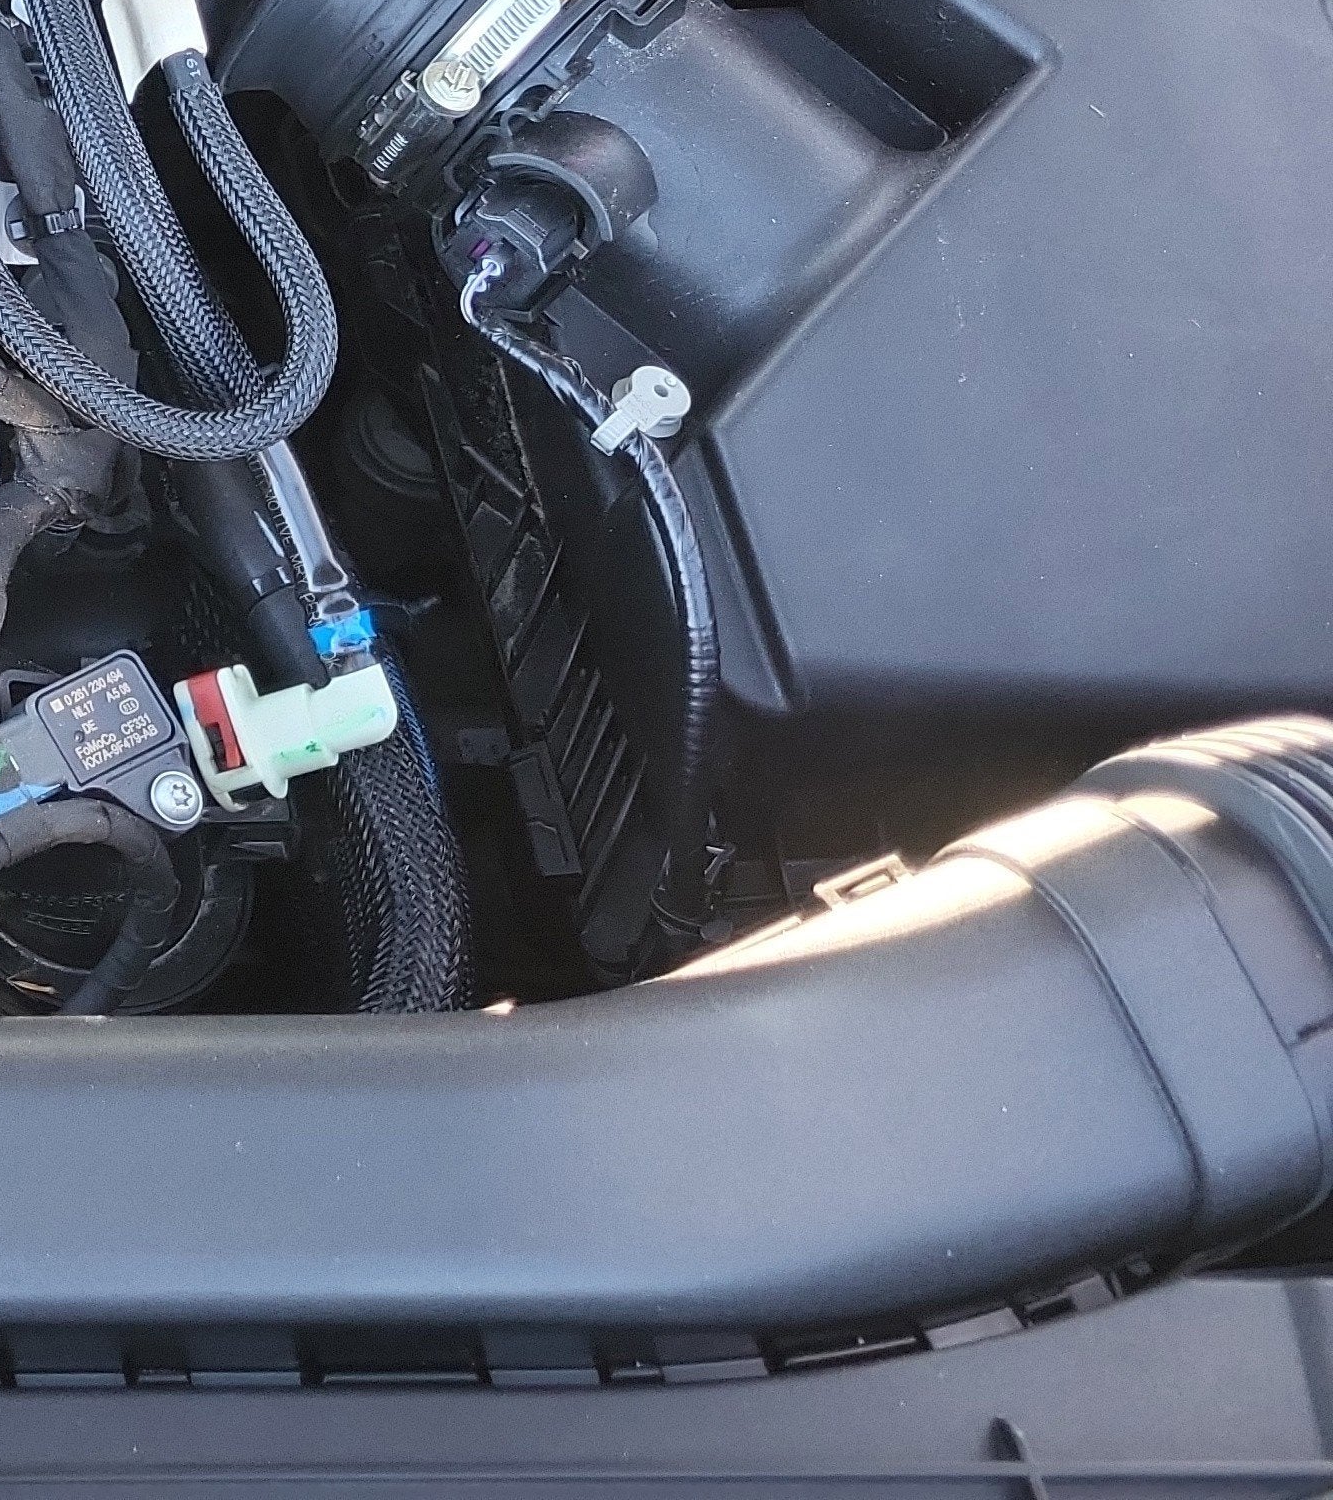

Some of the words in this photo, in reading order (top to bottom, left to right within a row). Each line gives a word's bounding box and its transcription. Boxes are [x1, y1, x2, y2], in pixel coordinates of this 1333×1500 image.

[369, 131, 410, 173] TRIDON
[70, 685, 89, 702] 261
[87, 676, 107, 693] 230
[103, 667, 124, 685] 494
[74, 730, 117, 759] FoMoCo
[119, 712, 151, 736] CF331
[80, 719, 98, 735] DE
